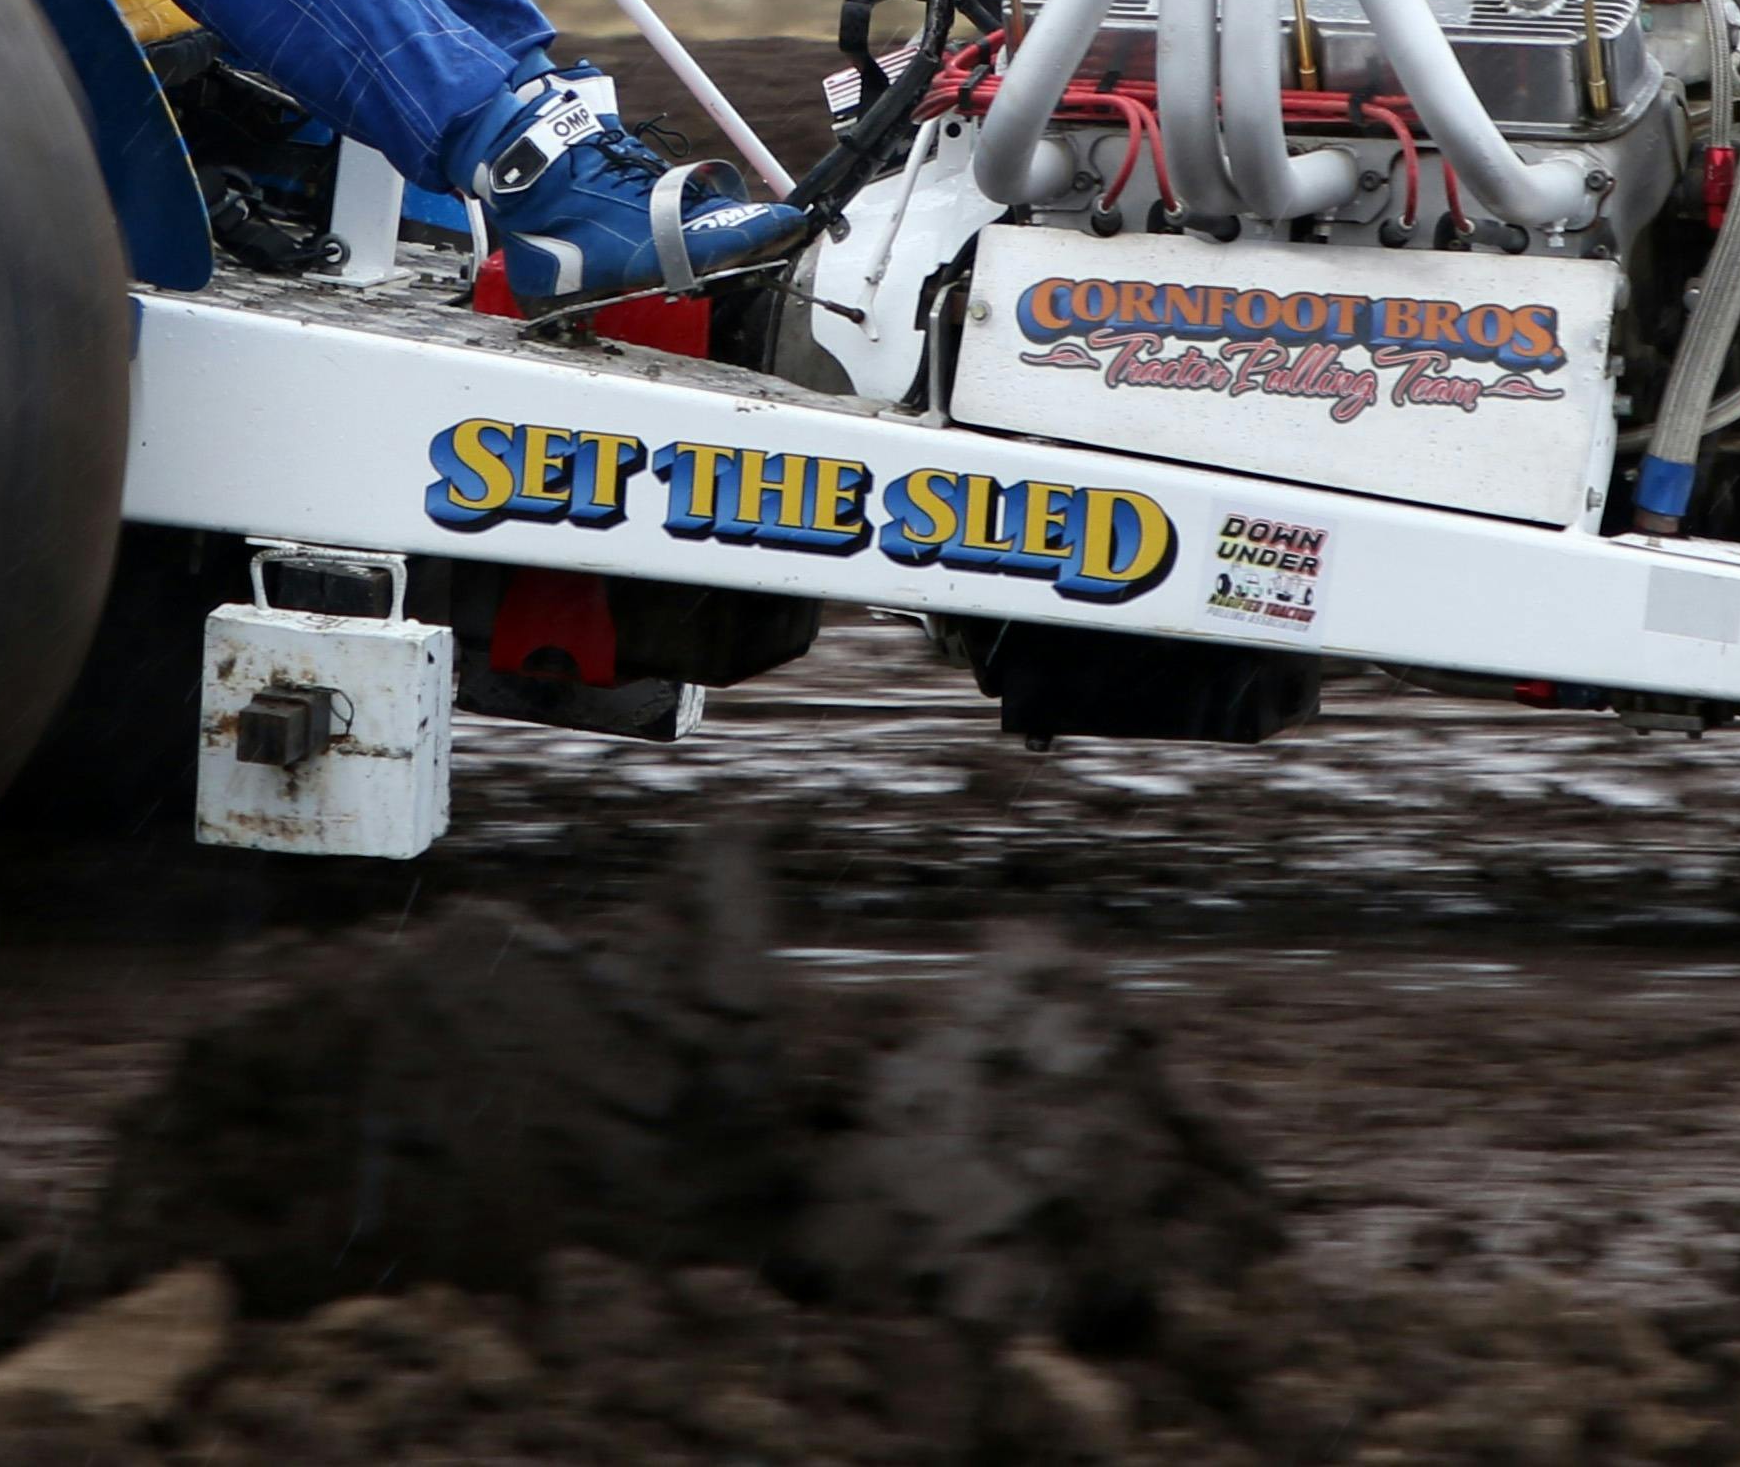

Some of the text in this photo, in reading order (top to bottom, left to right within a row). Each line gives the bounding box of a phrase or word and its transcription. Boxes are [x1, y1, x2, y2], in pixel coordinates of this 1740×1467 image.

[553, 108, 590, 137] OMP
[1017, 276, 1566, 373] CORNFOOT BROS.
[1088, 328, 1483, 423] Tractor Pulling Team
[425, 416, 1179, 606] SET THE SLED
[1218, 514, 1327, 552] DOWN
[1216, 541, 1322, 576] UNDER
